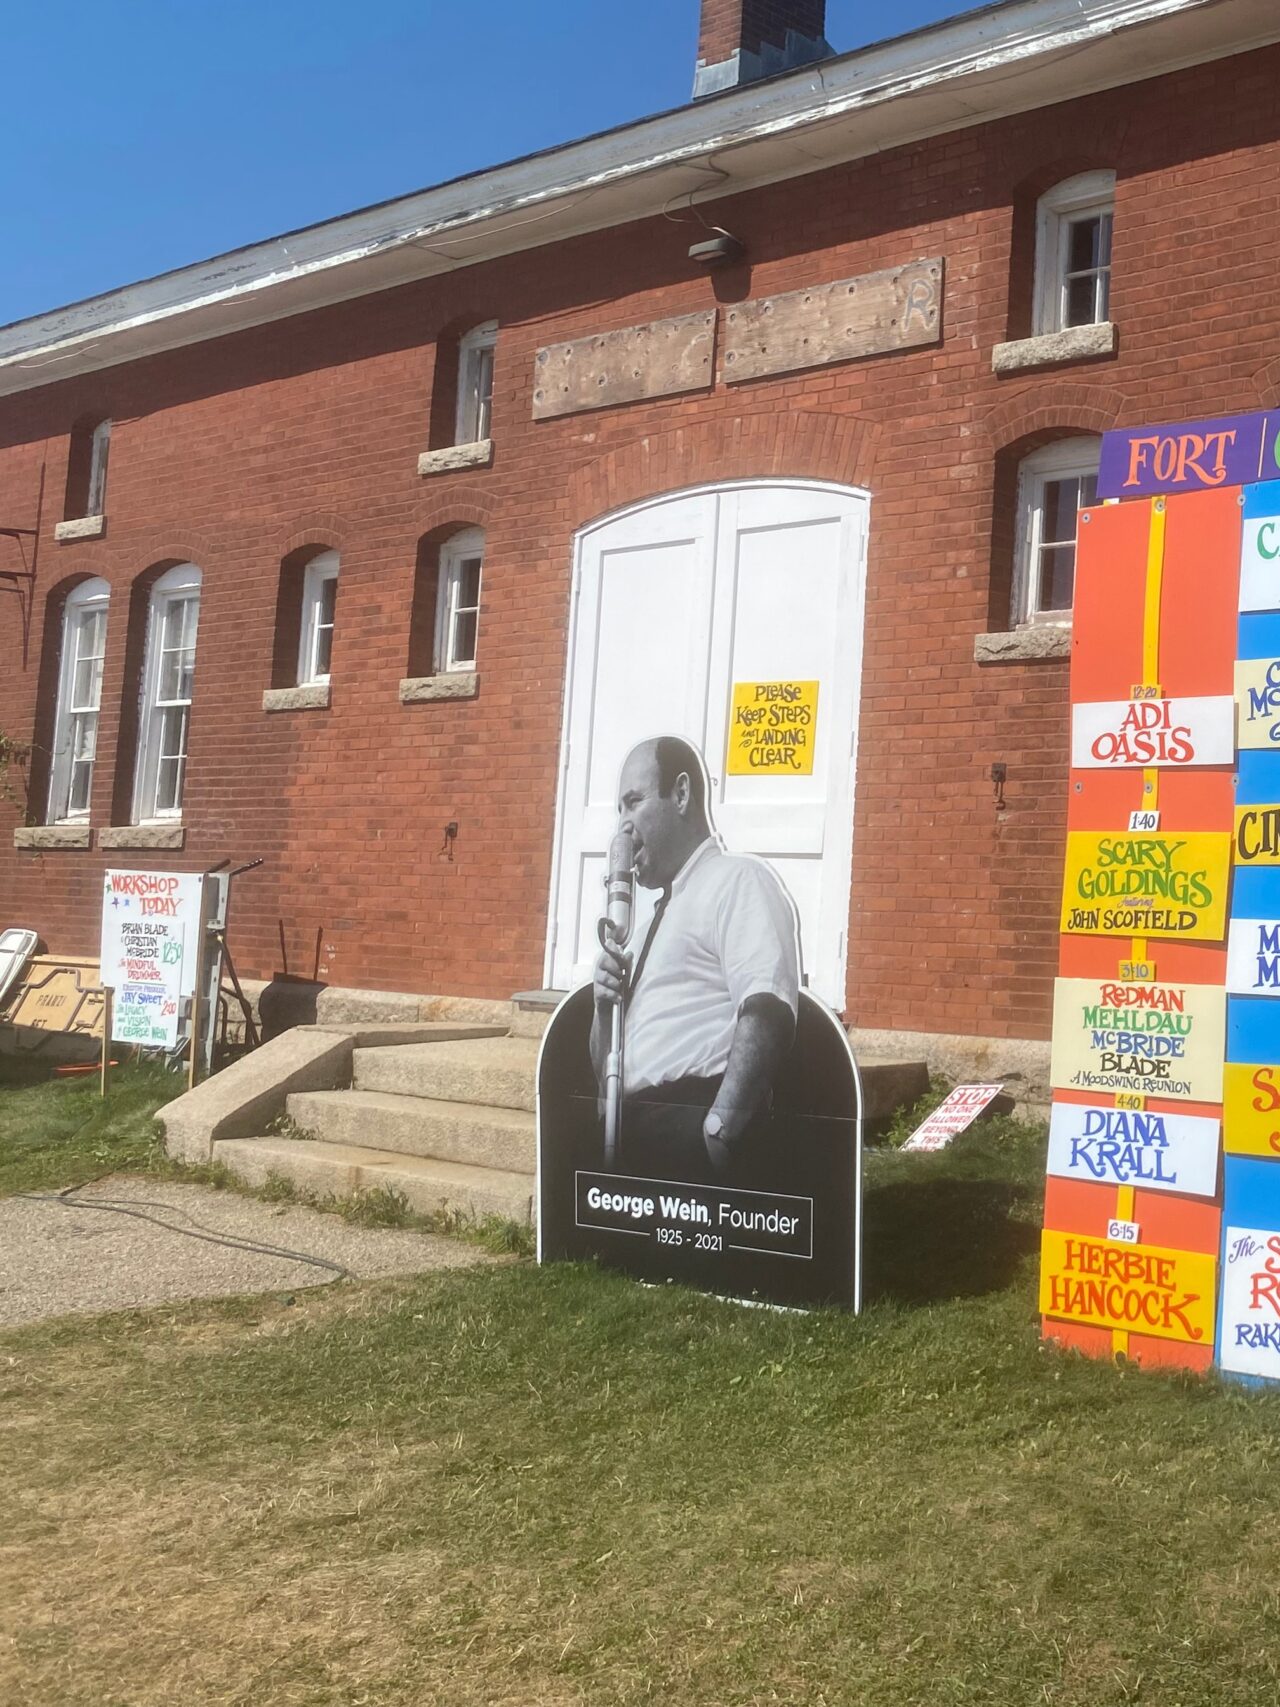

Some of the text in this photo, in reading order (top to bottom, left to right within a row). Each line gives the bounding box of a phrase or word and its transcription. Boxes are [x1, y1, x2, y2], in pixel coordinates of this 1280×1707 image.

[1122, 430, 1236, 487] FORT
[1133, 686, 1157, 699] 12:20
[1119, 700, 1172, 732] ADI
[755, 728, 806, 746] LANDING
[1091, 726, 1195, 764] OASIS
[1131, 813, 1156, 830] 1:40
[1097, 838, 1187, 871] SCARY
[111, 874, 179, 896] WORKSHOP
[1078, 868, 1213, 908] GOLDINGS
[140, 897, 184, 916] TODAY
[121, 922, 168, 936] BRIAN BLADE
[1068, 907, 1198, 931] JOHN SCOFIELD
[1121, 963, 1149, 978] 3:10
[122, 992, 137, 1004] JAY
[1082, 1006, 1193, 1035] MEHLDAU
[1099, 1052, 1172, 1079] BLADE
[1070, 1071, 1081, 1083] A
[1081, 1071, 1140, 1090] MOODSWING
[947, 1088, 997, 1105] STOP
[1117, 1094, 1141, 1110] 4:40
[1082, 1109, 1170, 1147] DIANA
[1069, 1138, 1177, 1184] KRALL
[587, 1187, 799, 1235] George Wein, Founder
[656, 1227, 723, 1251] 1925 2021
[1109, 1222, 1135, 1240] 6:15
[1228, 1235, 1264, 1264] The
[1064, 1239, 1177, 1292] HERBIE
[1049, 1275, 1203, 1340] HANCOCK
